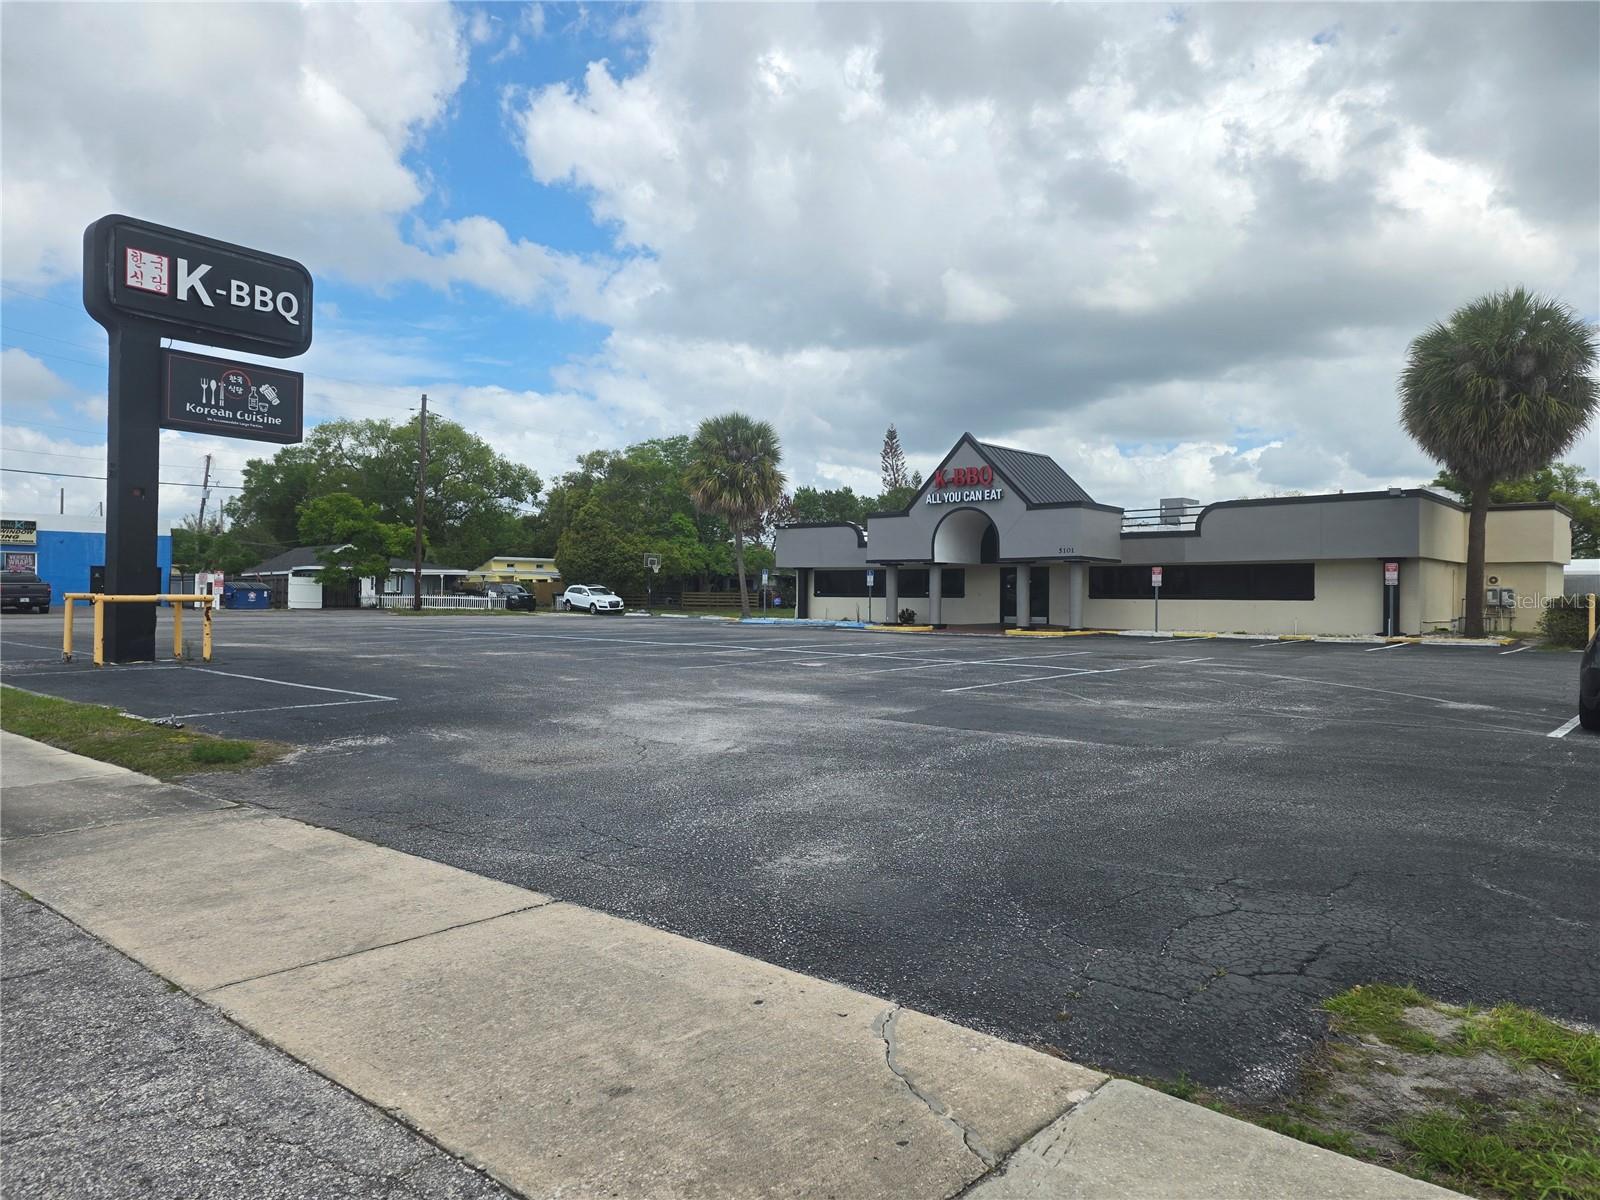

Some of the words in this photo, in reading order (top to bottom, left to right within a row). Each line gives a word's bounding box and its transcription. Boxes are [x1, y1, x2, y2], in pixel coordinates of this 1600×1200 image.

[130, 250, 162, 273] 한국
[130, 269, 167, 291] 식당
[176, 257, 300, 325] K-BBQ
[186, 402, 233, 418] Korean
[236, 410, 282, 425] Cuisine
[934, 464, 994, 490] K-BBQ
[925, 494, 942, 505] ALL
[943, 491, 961, 503] YOU
[963, 490, 983, 501] CAN
[984, 488, 1002, 500] EAT
